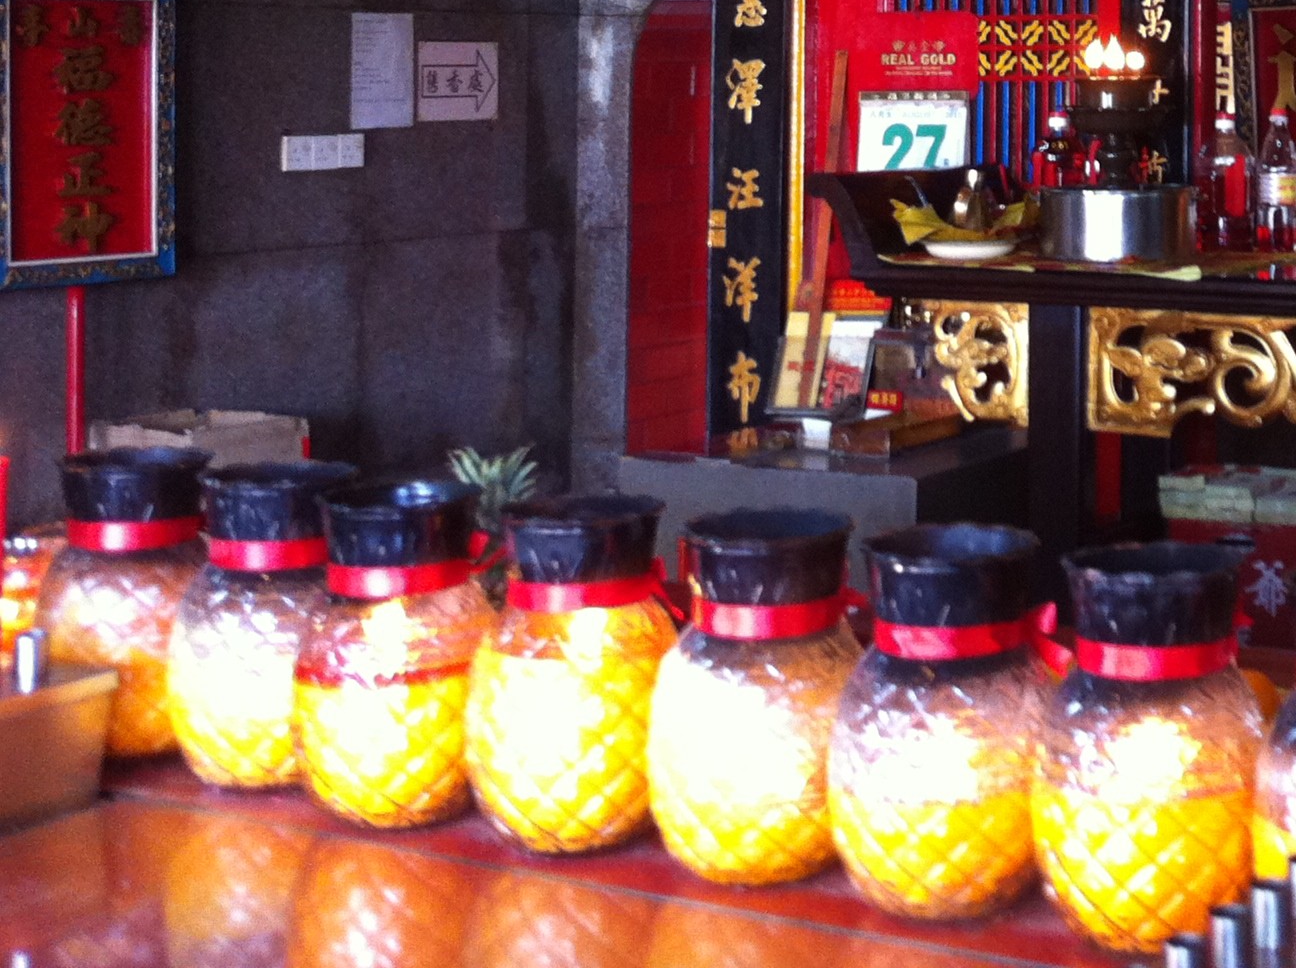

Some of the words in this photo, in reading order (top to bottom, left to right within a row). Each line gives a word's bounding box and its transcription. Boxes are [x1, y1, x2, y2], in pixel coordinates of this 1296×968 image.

[881, 54, 915, 65] REAL
[920, 54, 957, 65] GOLD
[53, 46, 115, 251] 福德正神
[882, 123, 947, 170] 27
